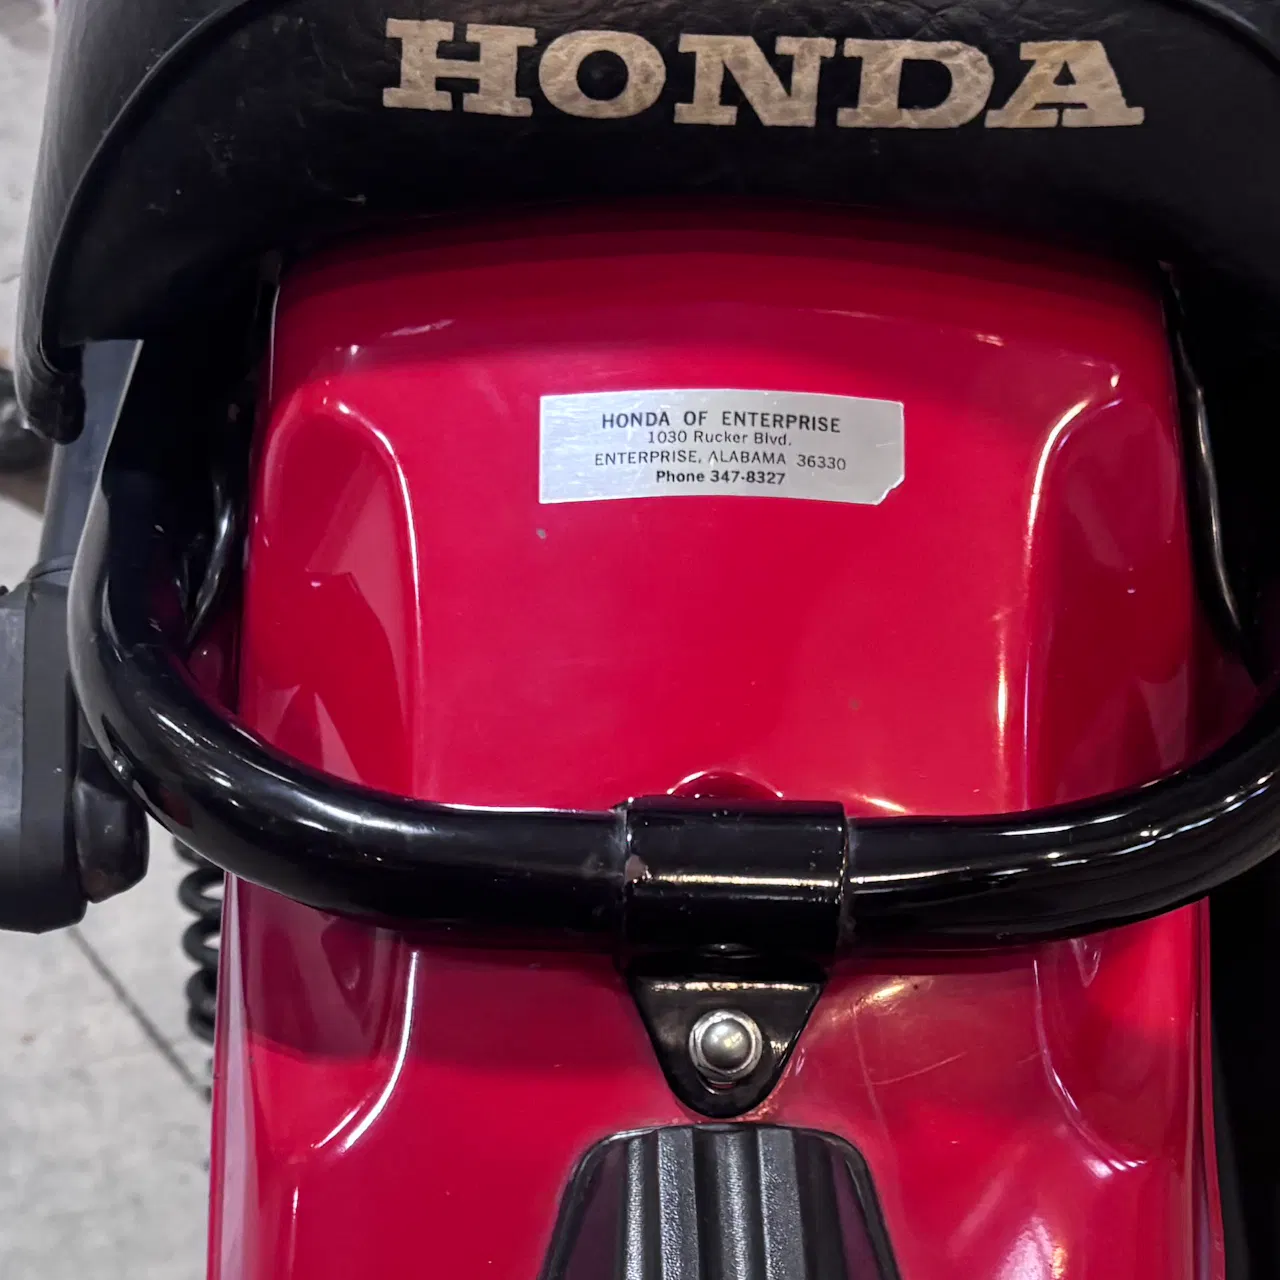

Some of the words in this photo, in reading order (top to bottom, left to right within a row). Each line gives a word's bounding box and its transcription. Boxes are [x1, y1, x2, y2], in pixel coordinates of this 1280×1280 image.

[381, 18, 1145, 130] HONDA
[602, 411, 670, 429] HONDA
[683, 410, 708, 426] OF
[722, 411, 841, 433] ENTERPRISE
[648, 431, 687, 444] 1030
[693, 430, 748, 444] Rucker
[754, 432, 792, 446] Blvd.
[595, 450, 702, 466] ENTERPRISE,
[708, 450, 786, 465] ALABAMA
[796, 453, 846, 471] 36330
[656, 470, 705, 483] Phone
[710, 470, 786, 485] 347-8327
